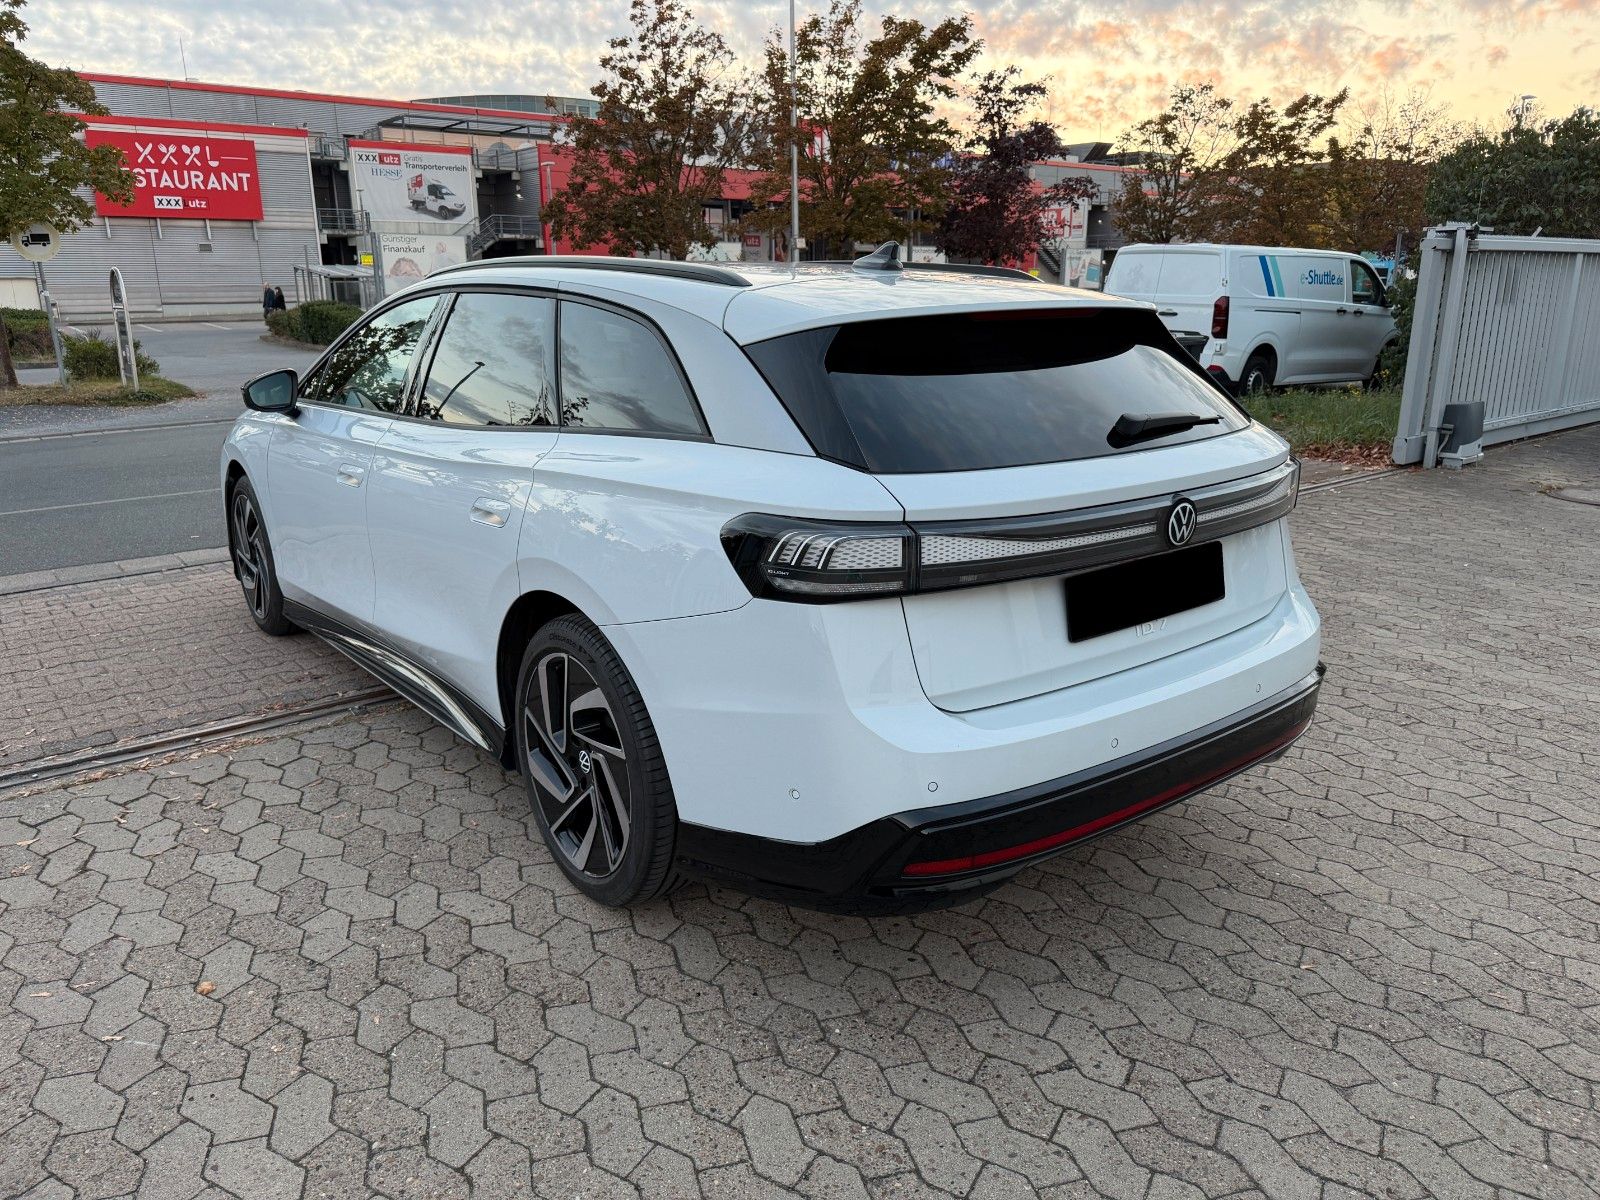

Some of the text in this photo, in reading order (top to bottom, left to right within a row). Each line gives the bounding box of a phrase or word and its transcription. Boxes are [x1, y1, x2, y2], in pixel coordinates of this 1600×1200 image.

[371, 167, 402, 177] HESSE
[404, 162, 468, 172] Transporterverleih
[120, 167, 251, 192] STAURANT
[382, 244, 425, 253] Finanzkauf
[1300, 269, 1344, 286] e-Shuttle.de
